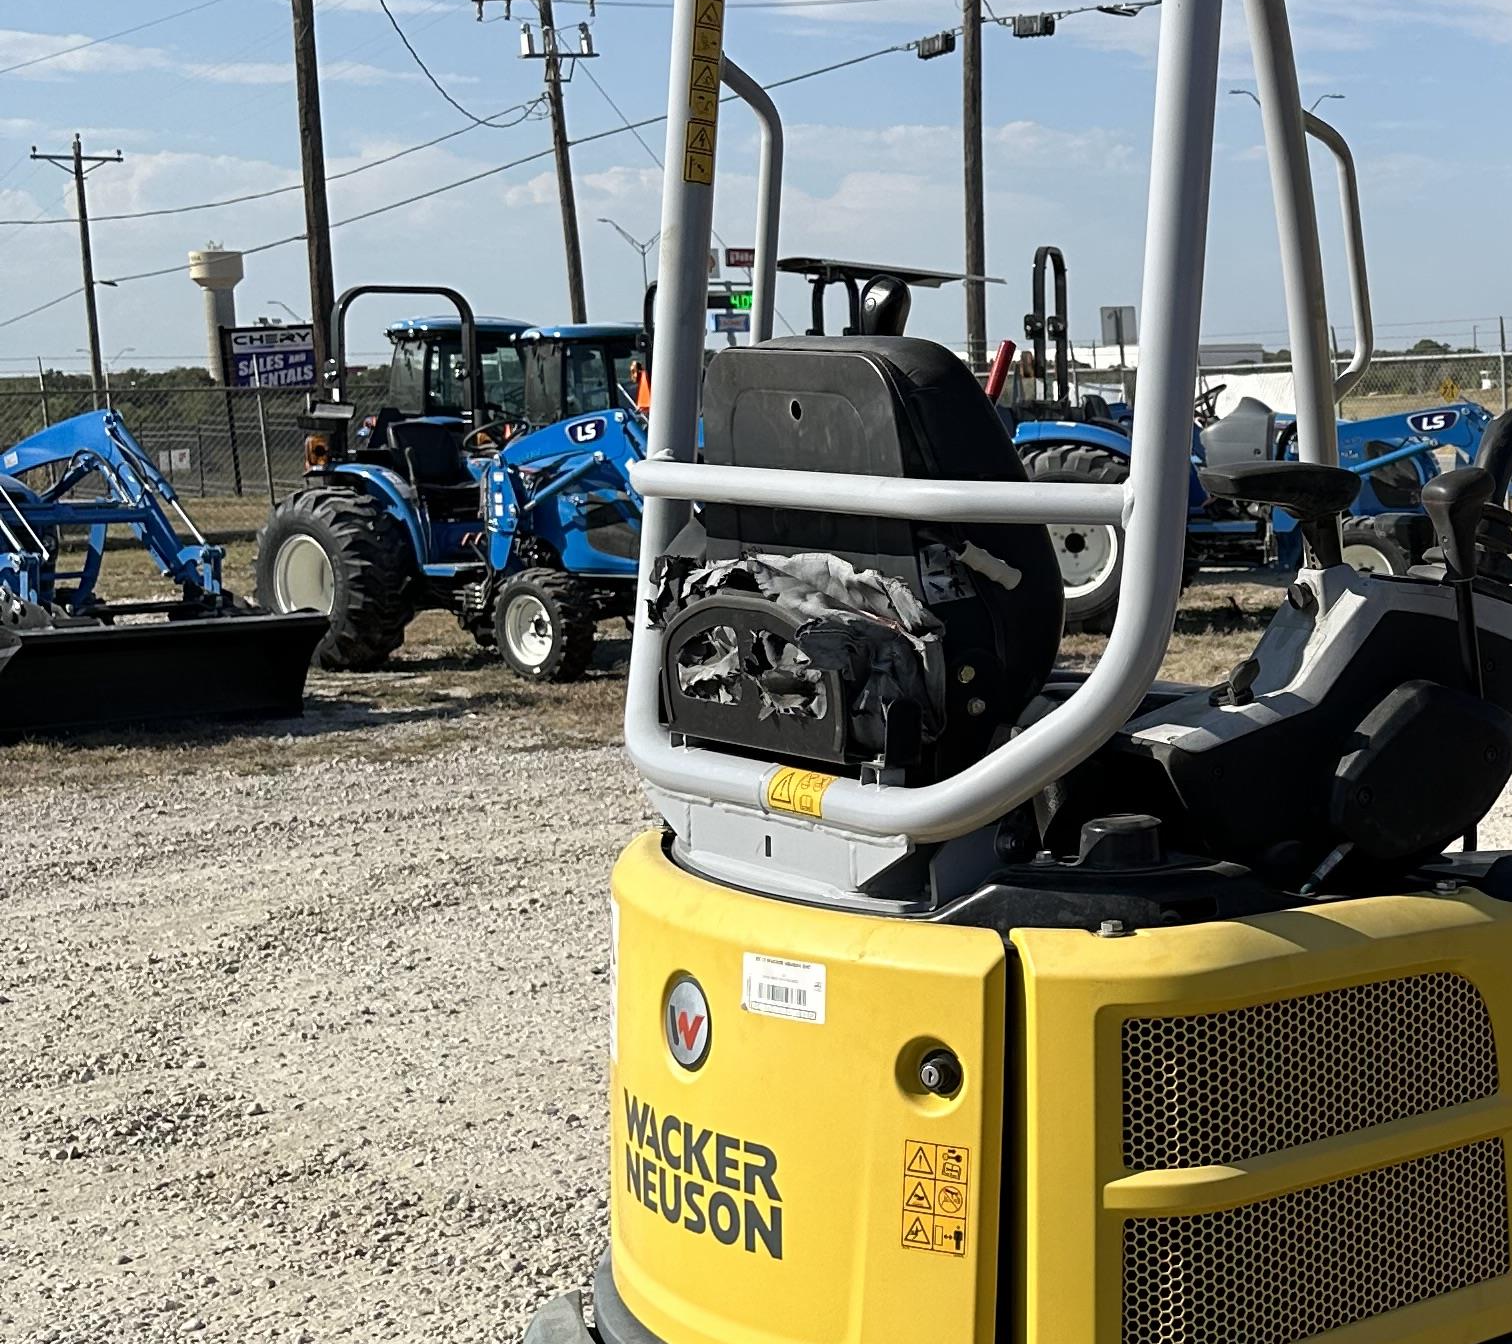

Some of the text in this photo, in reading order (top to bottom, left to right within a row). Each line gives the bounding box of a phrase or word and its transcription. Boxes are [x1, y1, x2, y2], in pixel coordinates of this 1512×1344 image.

[576, 422, 597, 442] LS
[1421, 415, 1446, 431] LS
[623, 1086, 783, 1203] WACKER
[625, 1142, 783, 1260] NEUSON
